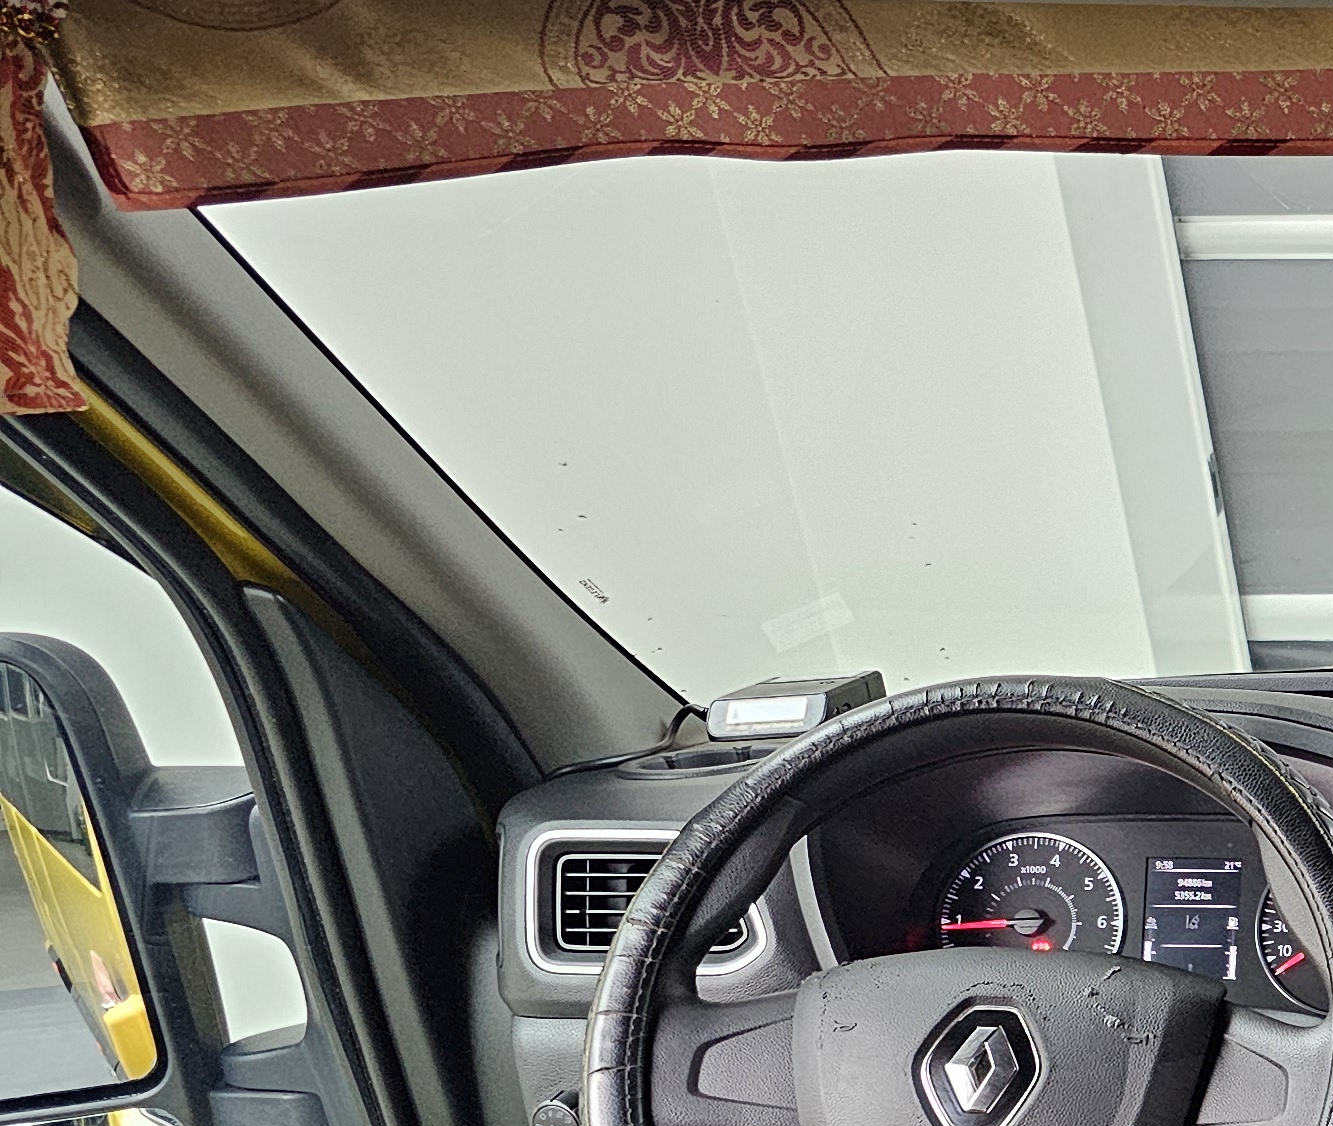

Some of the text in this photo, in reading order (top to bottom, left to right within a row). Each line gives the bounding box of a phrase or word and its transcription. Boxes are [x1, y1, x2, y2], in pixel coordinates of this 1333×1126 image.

[1008, 854, 1019, 867] 3
[1050, 854, 1061, 868] 4
[1155, 860, 1174, 870] 9:58
[1020, 865, 1047, 874] x1000
[973, 877, 984, 890] 2
[1084, 877, 1094, 891] 5
[1097, 915, 1107, 929] 6
[1277, 945, 1292, 957] 10
